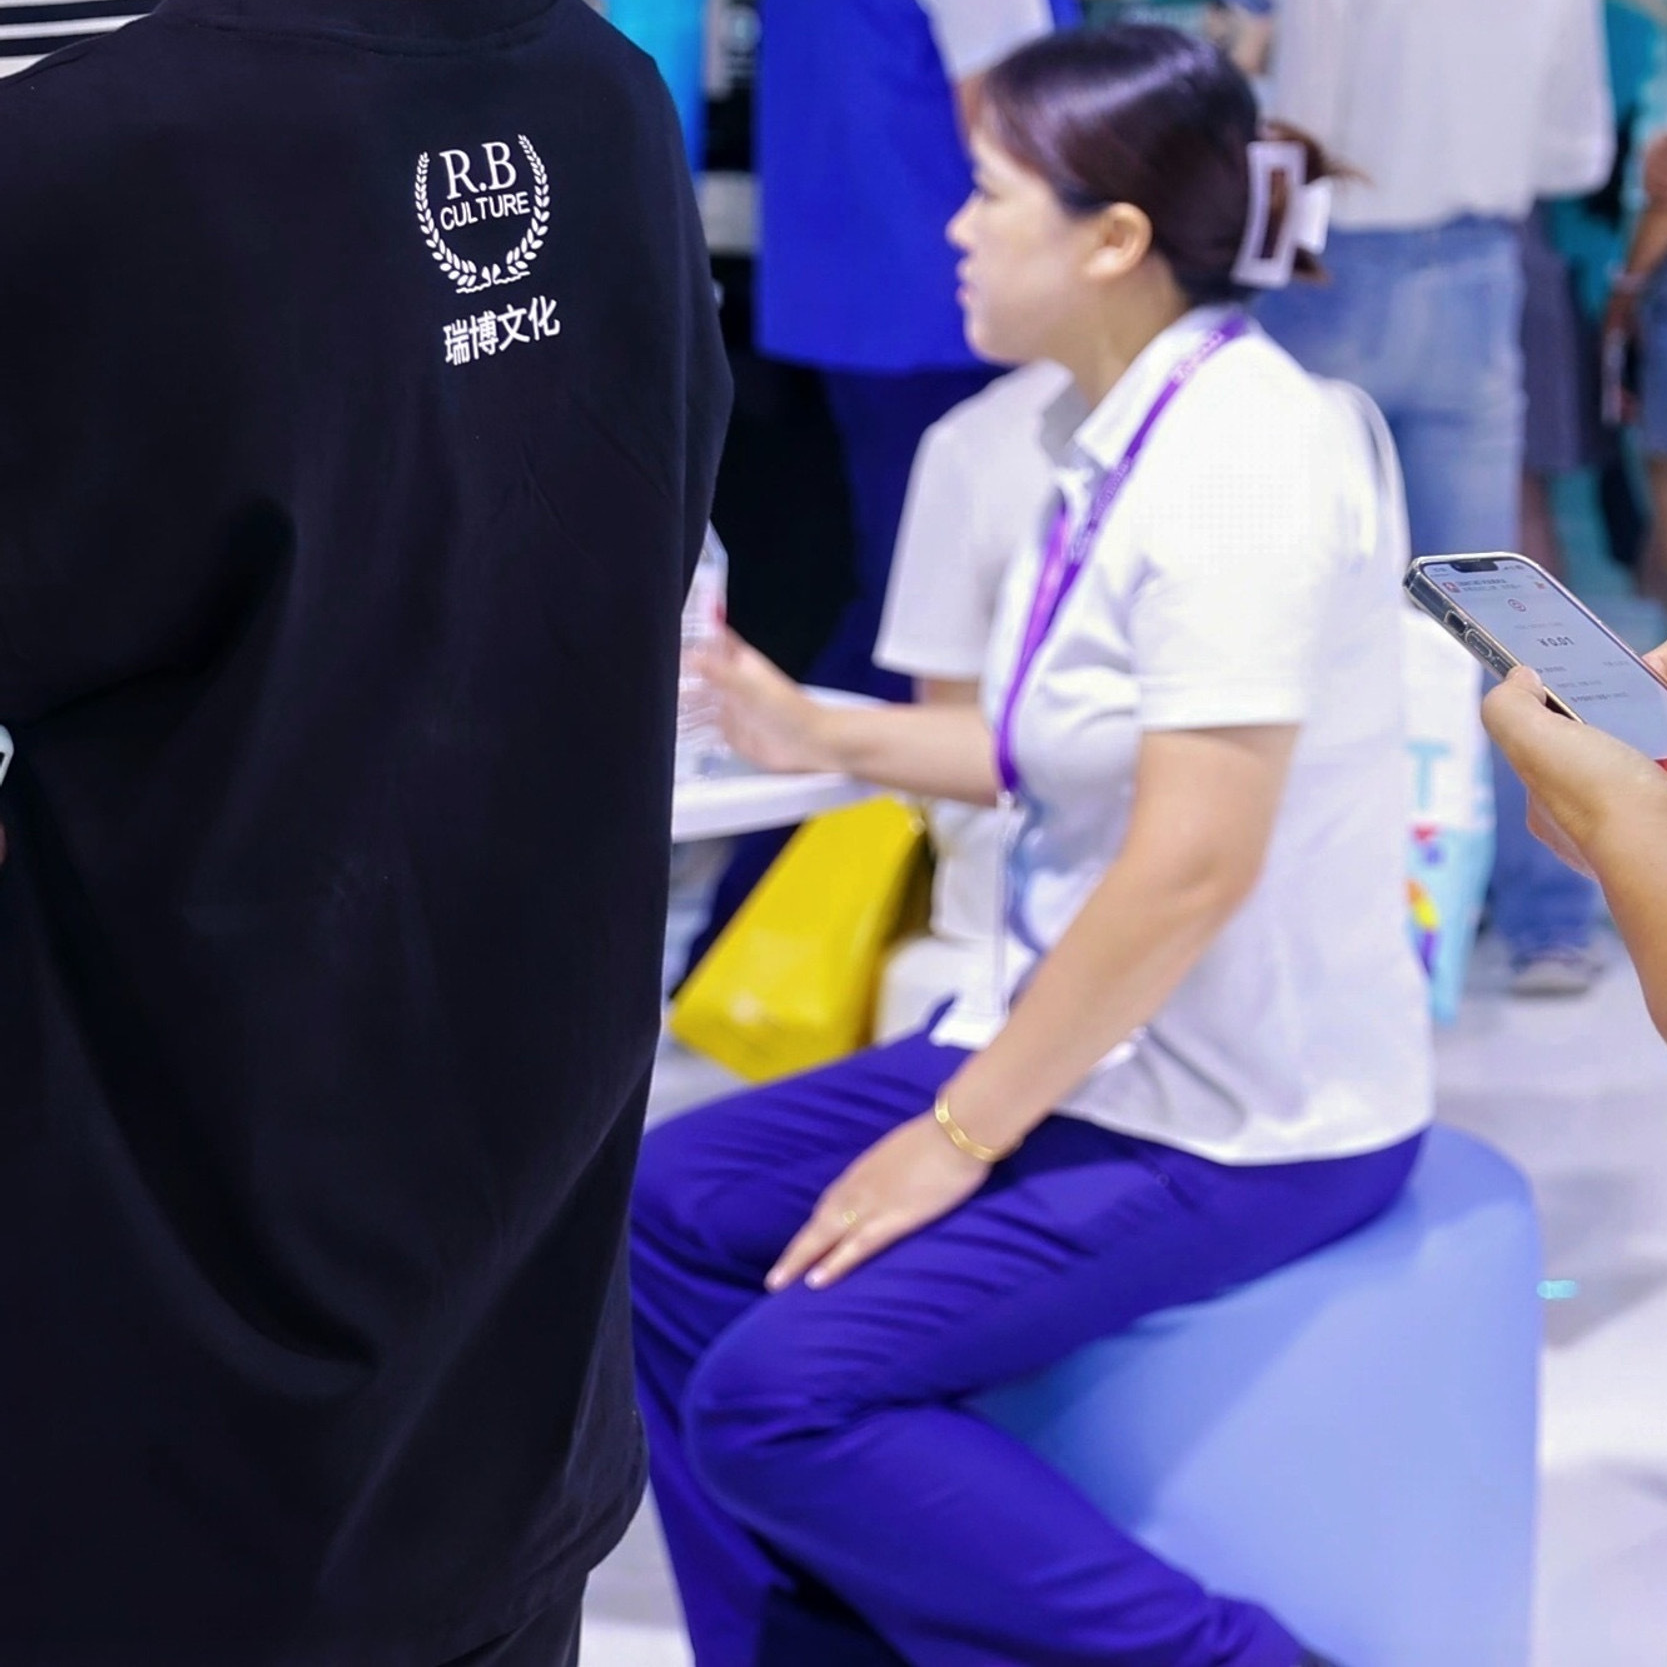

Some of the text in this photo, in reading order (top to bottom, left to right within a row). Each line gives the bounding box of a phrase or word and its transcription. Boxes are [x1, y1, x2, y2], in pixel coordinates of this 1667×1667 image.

[439, 141, 517, 200] R.B
[440, 191, 531, 231] CULTURE
[443, 295, 560, 366] 瑞博文化
